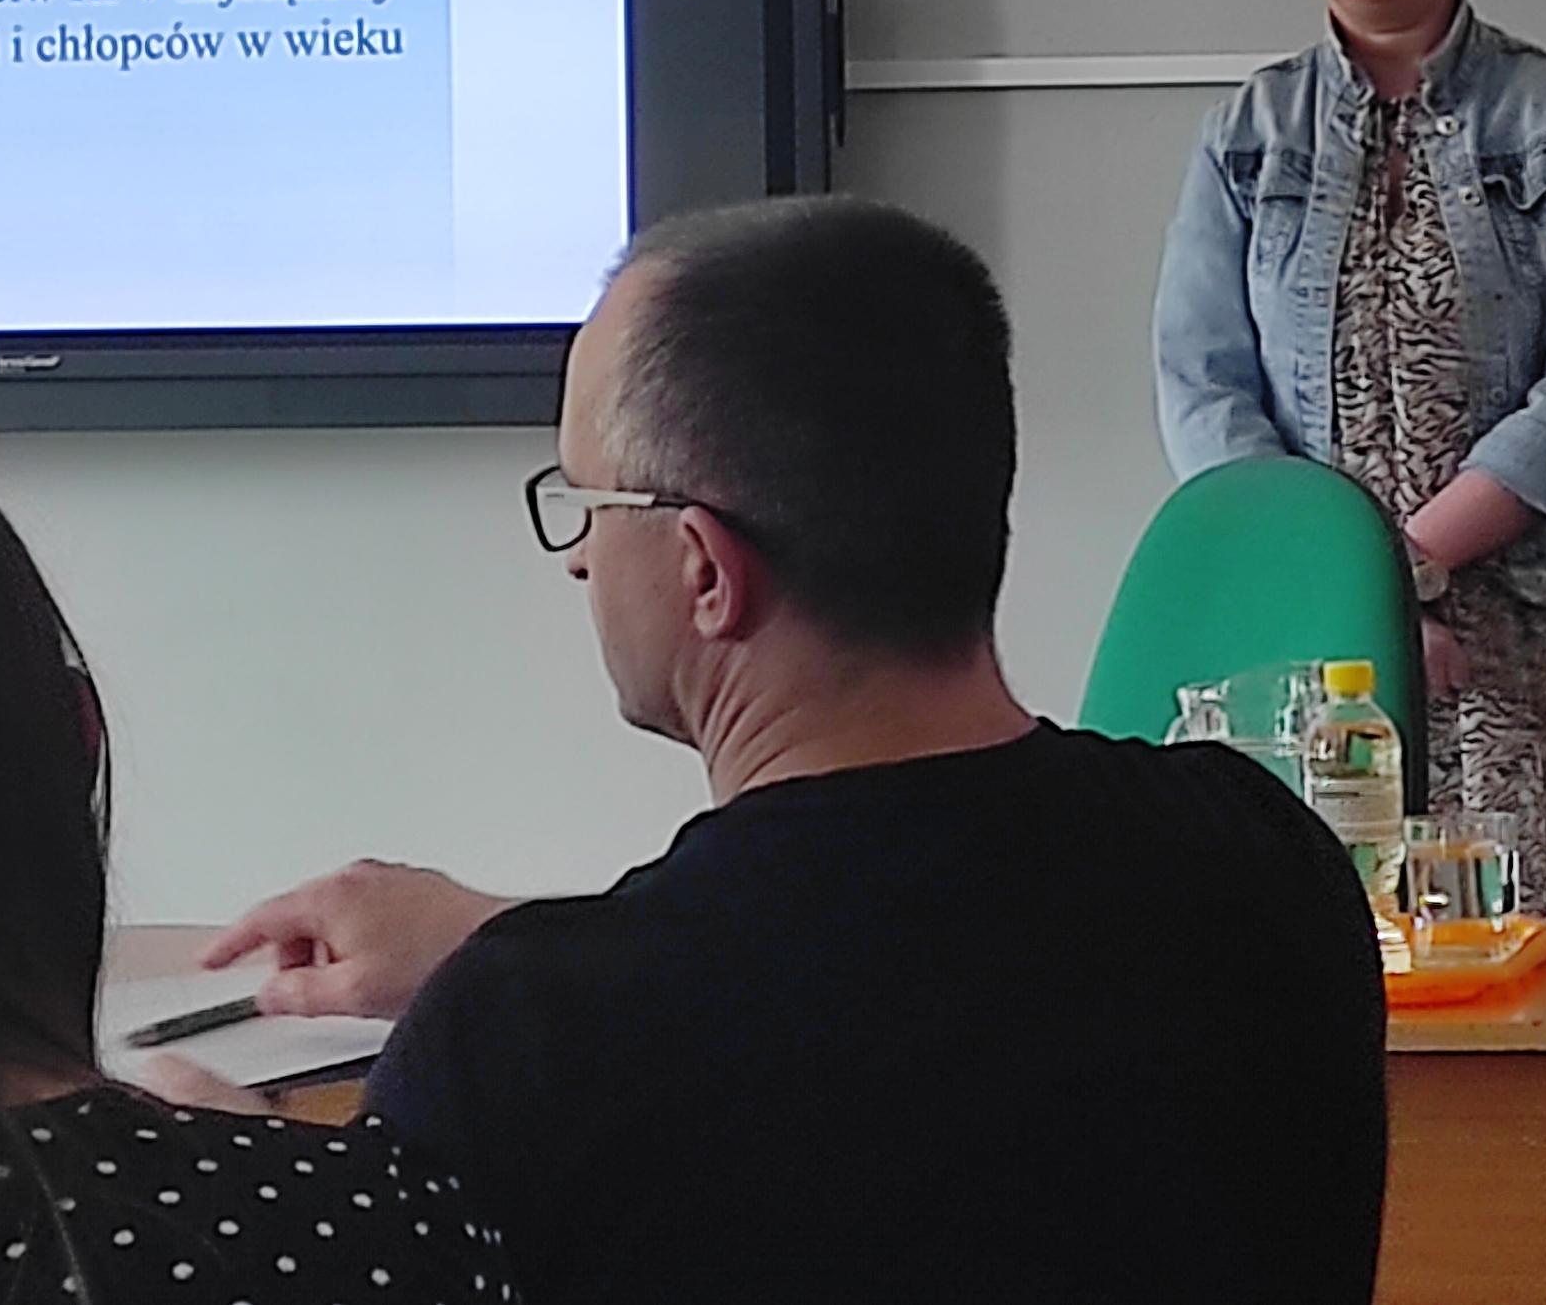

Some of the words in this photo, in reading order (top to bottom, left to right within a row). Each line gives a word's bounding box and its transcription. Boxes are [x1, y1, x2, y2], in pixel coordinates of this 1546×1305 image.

[11, 23, 24, 64] i
[35, 20, 226, 73] chłopców
[235, 29, 273, 59] w
[282, 16, 404, 58] wieku
